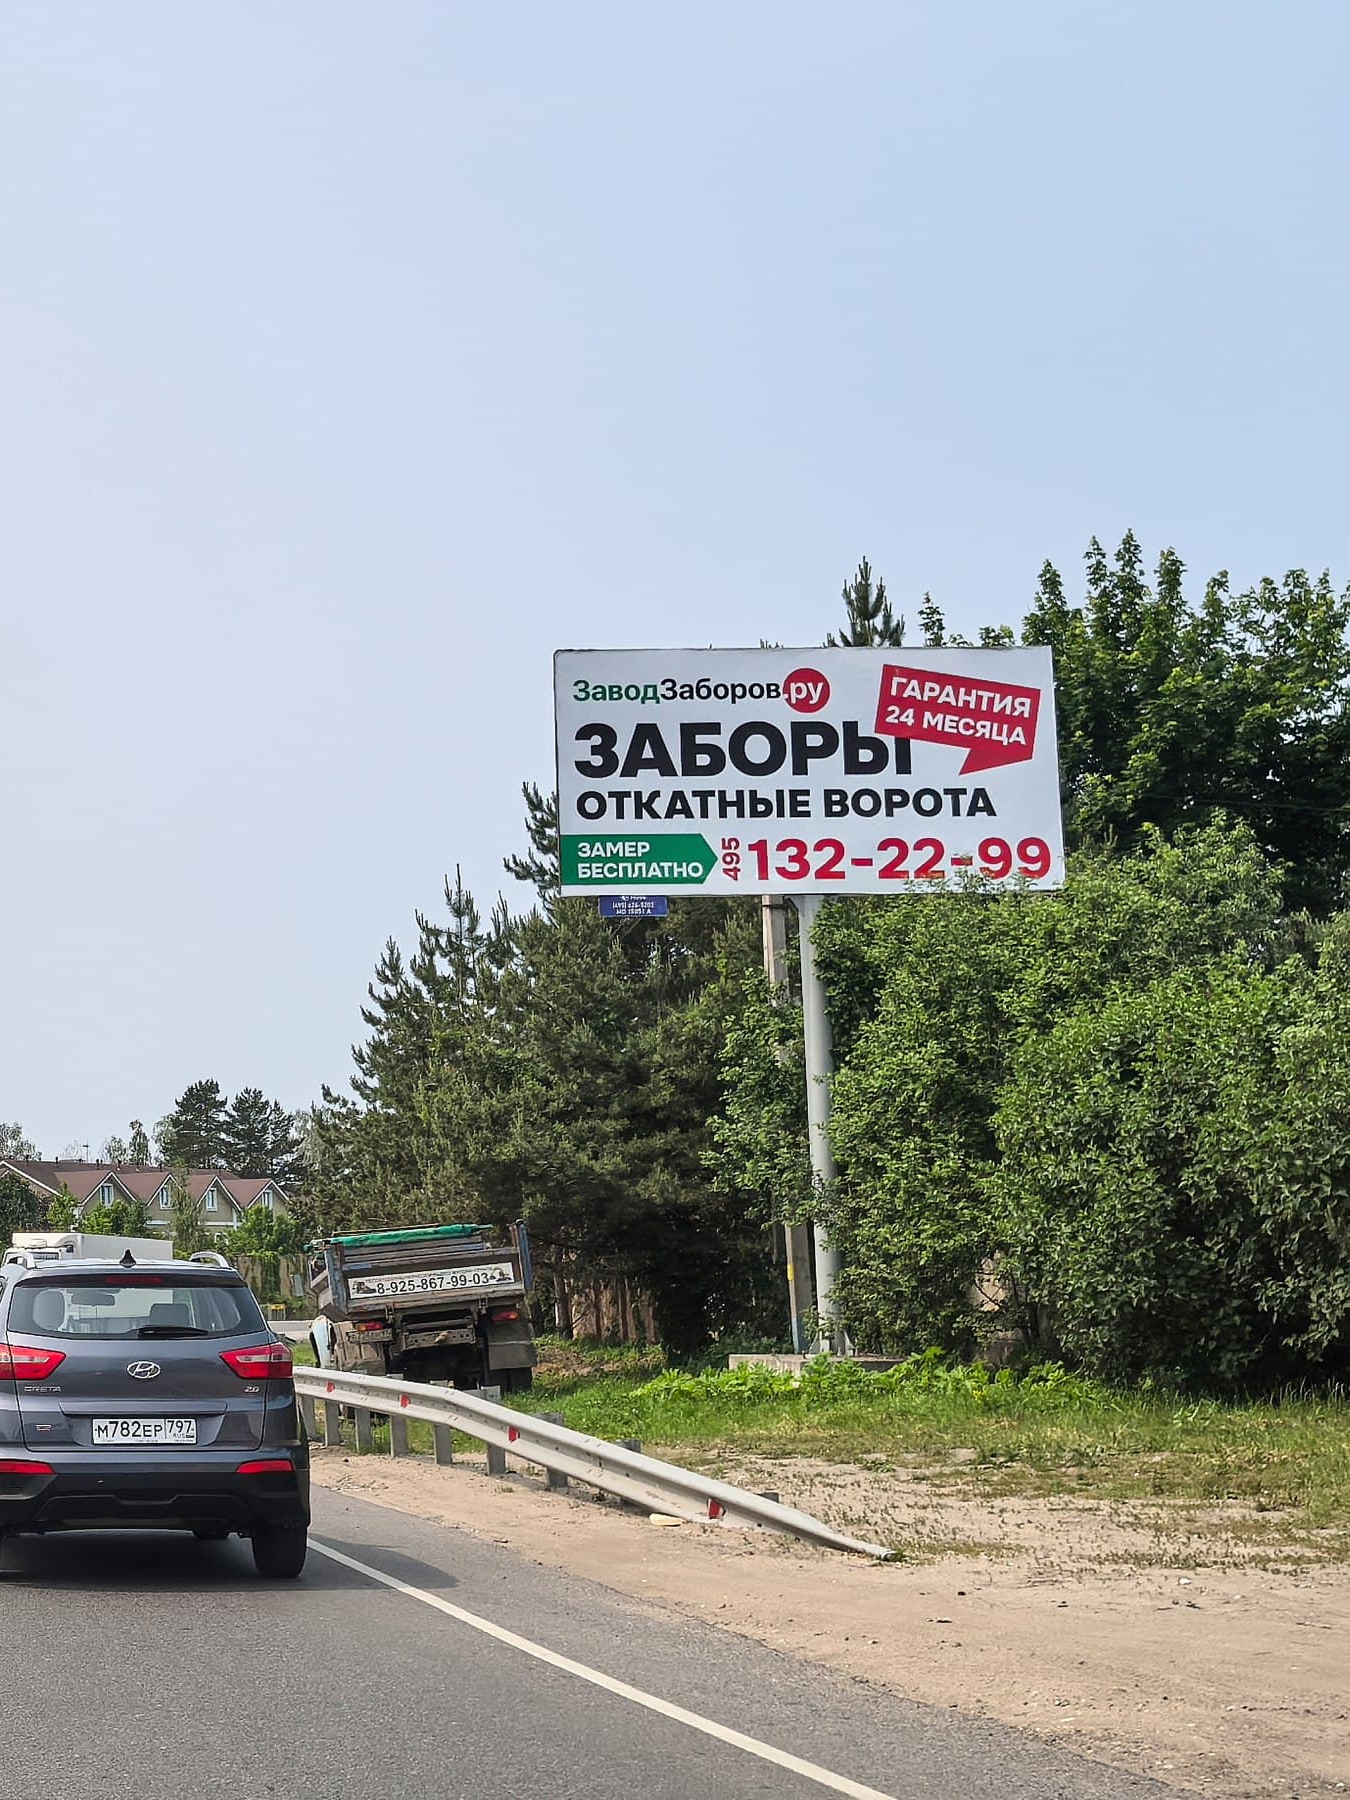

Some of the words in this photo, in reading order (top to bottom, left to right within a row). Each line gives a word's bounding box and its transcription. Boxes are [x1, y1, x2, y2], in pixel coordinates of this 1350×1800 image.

[572, 677, 824, 705] ЗаводЗаборов.ру
[890, 676, 1031, 719] ГАРАНТИЯ
[885, 705, 915, 726] 24
[922, 711, 1027, 746] МЕСЯЦА
[574, 720, 912, 779] ЗАБОРЫ
[576, 788, 812, 820] ОТКАТНЫЕ
[823, 787, 997, 818] ВОРОТА
[577, 841, 651, 858] ЗАМЕР
[721, 836, 742, 882] 495
[747, 836, 1052, 881] 132-22-99
[577, 861, 704, 879] БЕСПЛАТНО
[376, 1272, 490, 1294] 8-925-867-99-03
